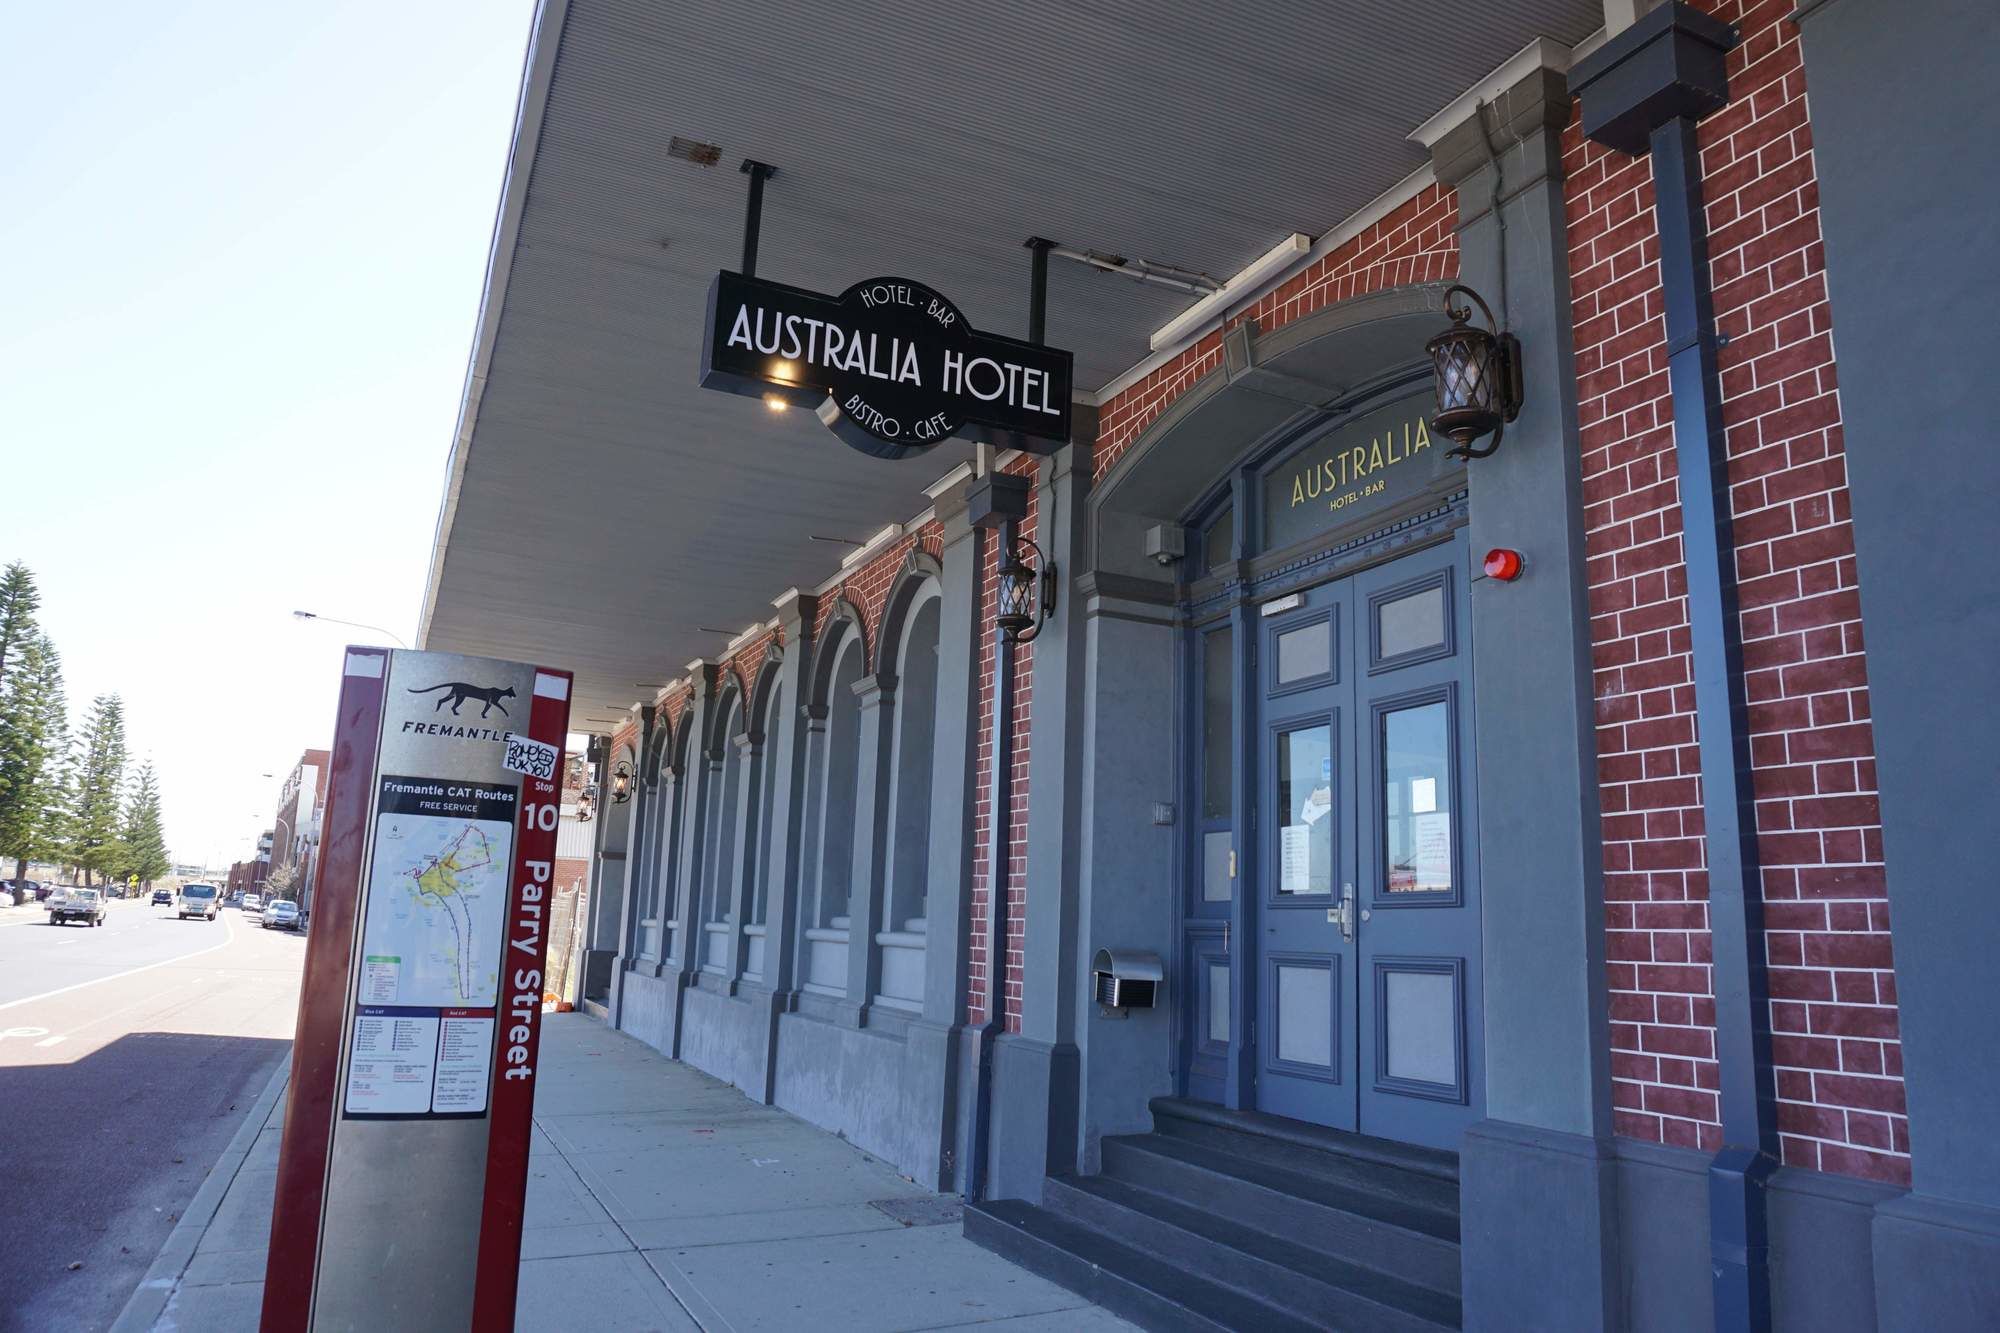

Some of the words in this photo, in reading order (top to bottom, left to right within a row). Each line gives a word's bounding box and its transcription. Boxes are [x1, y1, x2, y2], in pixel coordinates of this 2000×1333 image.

[860, 284, 915, 309] HOTEL
[927, 299, 955, 329] BAR
[727, 303, 922, 387] AUSTRALIA
[942, 349, 1061, 416] HOTEL
[844, 393, 901, 439] BISTRO
[914, 411, 953, 440] CAFE
[1291, 416, 1431, 508] AUSTRALIA
[1329, 492, 1359, 512] HOTEL
[1365, 480, 1385, 497] BAR
[402, 721, 513, 743] FREMANTLE
[384, 781, 444, 796] Fremantle
[447, 787, 471, 799] CAT
[475, 790, 514, 802] Routes
[535, 781, 554, 793] Stop
[419, 801, 441, 810] FREE
[443, 802, 478, 813] SERVICE
[524, 802, 558, 832] 10
[511, 860, 550, 956] Parry
[505, 968, 541, 1081] Street
